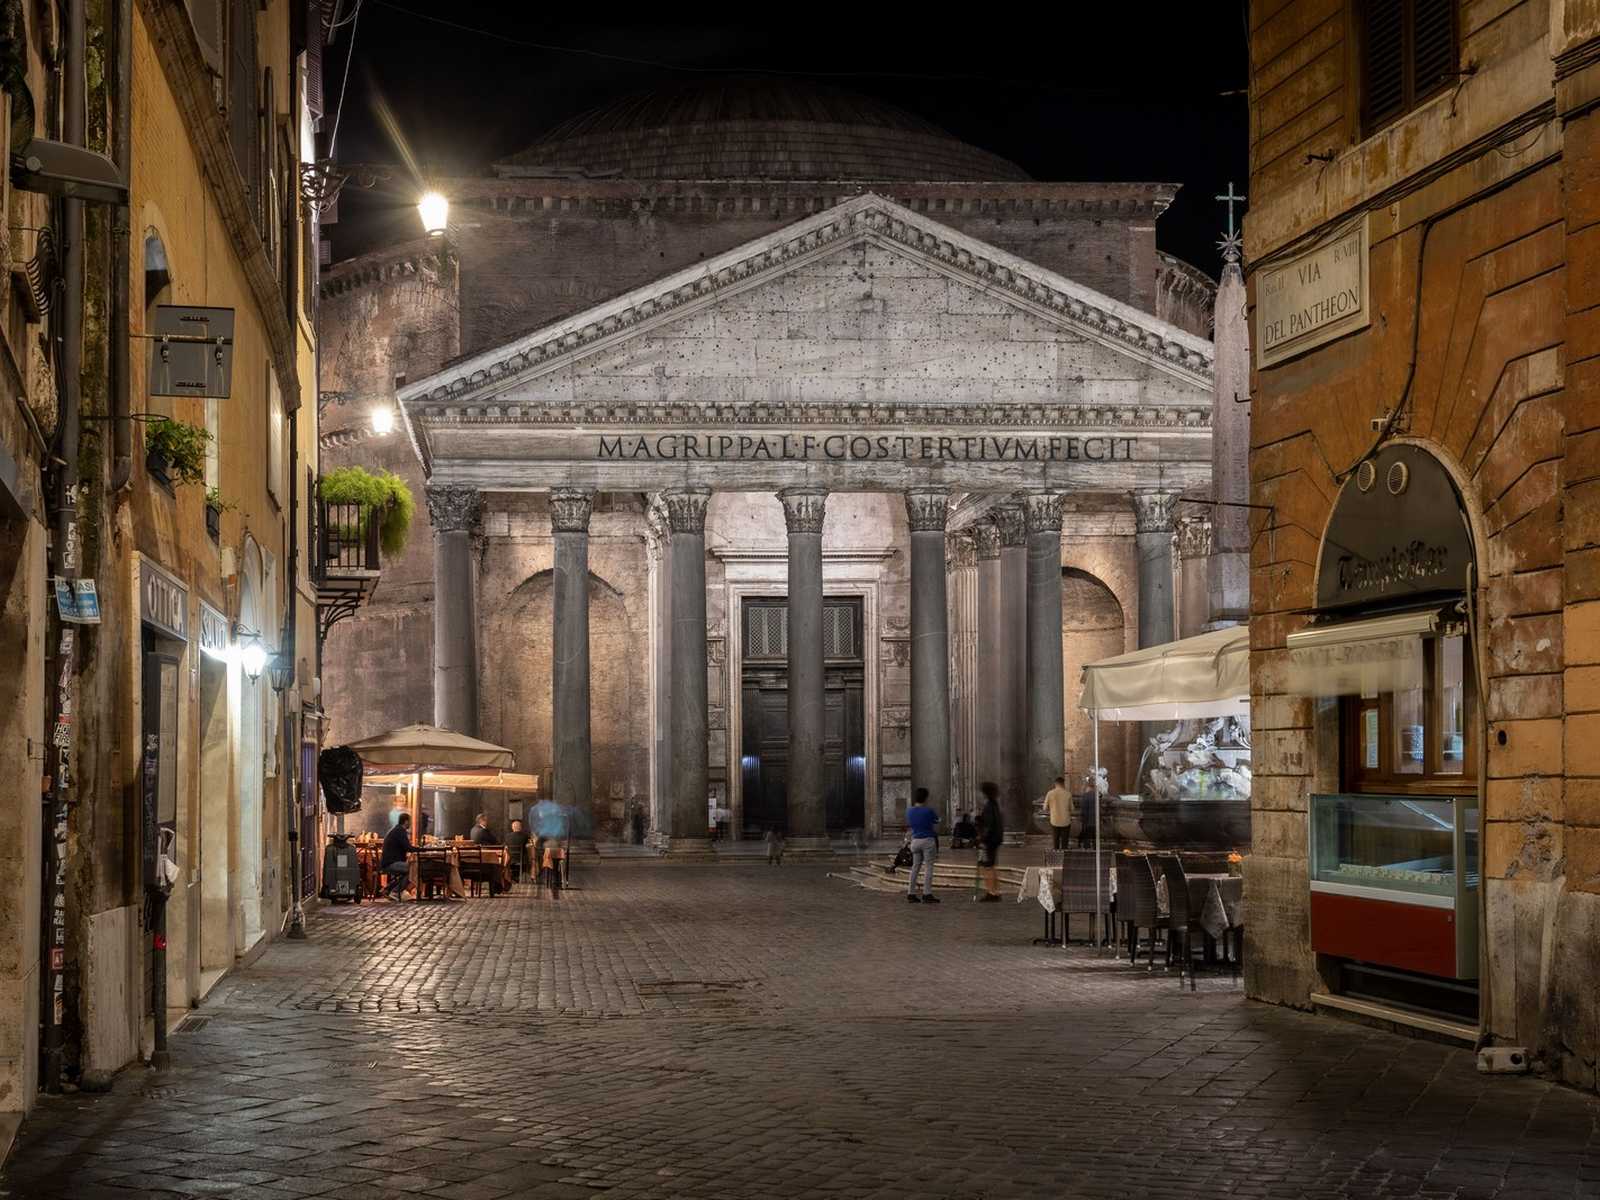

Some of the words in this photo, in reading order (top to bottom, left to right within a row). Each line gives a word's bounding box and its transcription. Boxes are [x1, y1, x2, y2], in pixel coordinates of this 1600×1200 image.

[1298, 261, 1321, 286] VIA
[1265, 319, 1286, 345] DEL
[1290, 286, 1358, 334] PANTHEON
